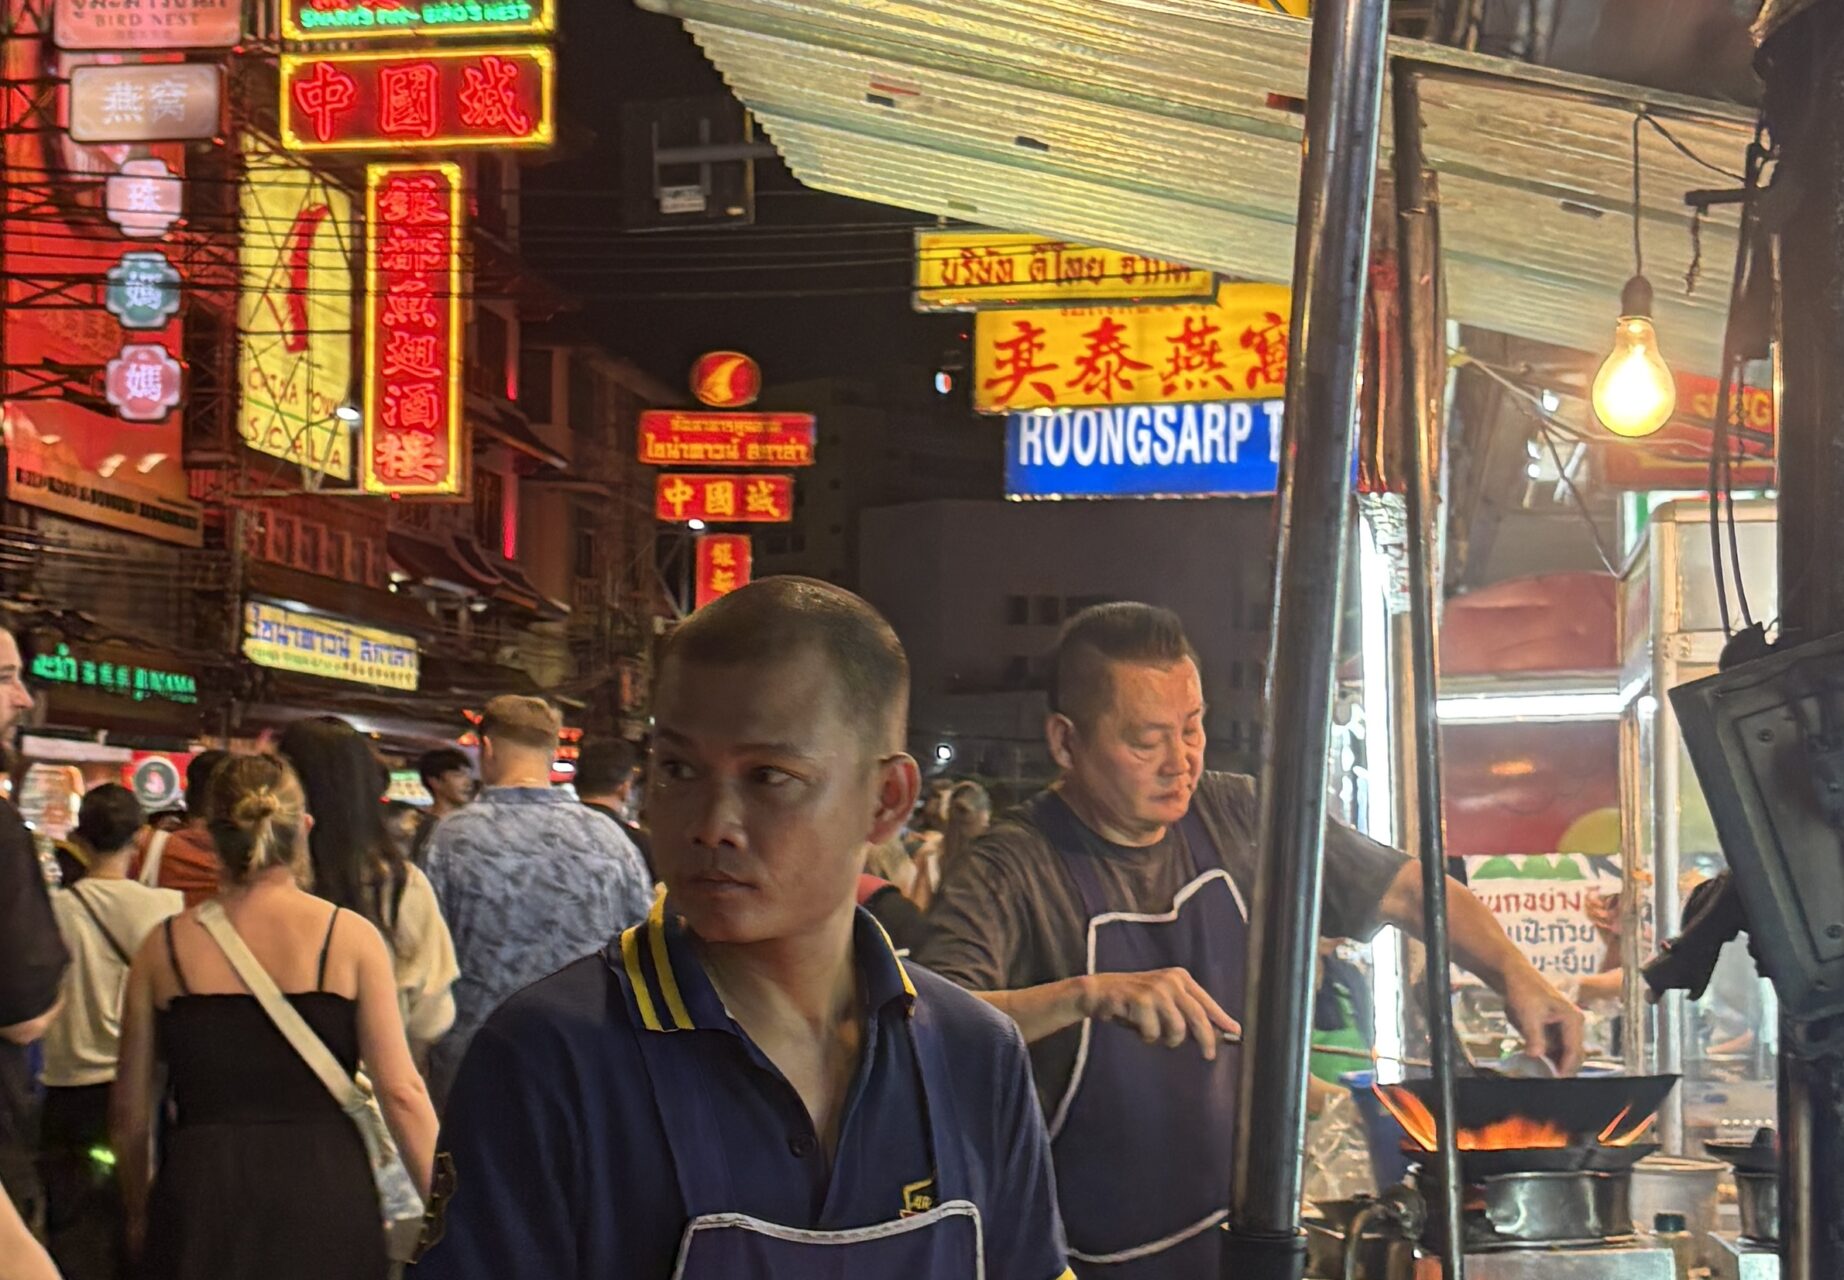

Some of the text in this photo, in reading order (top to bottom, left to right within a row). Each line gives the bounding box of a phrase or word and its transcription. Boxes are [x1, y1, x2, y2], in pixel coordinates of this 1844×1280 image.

[95, 11, 200, 28] BIRD NEST
[294, 61, 529, 142] 中國城
[248, 416, 342, 471] SCALA
[1018, 401, 1251, 467] ROONGSARP
[664, 478, 781, 518] 中國城
